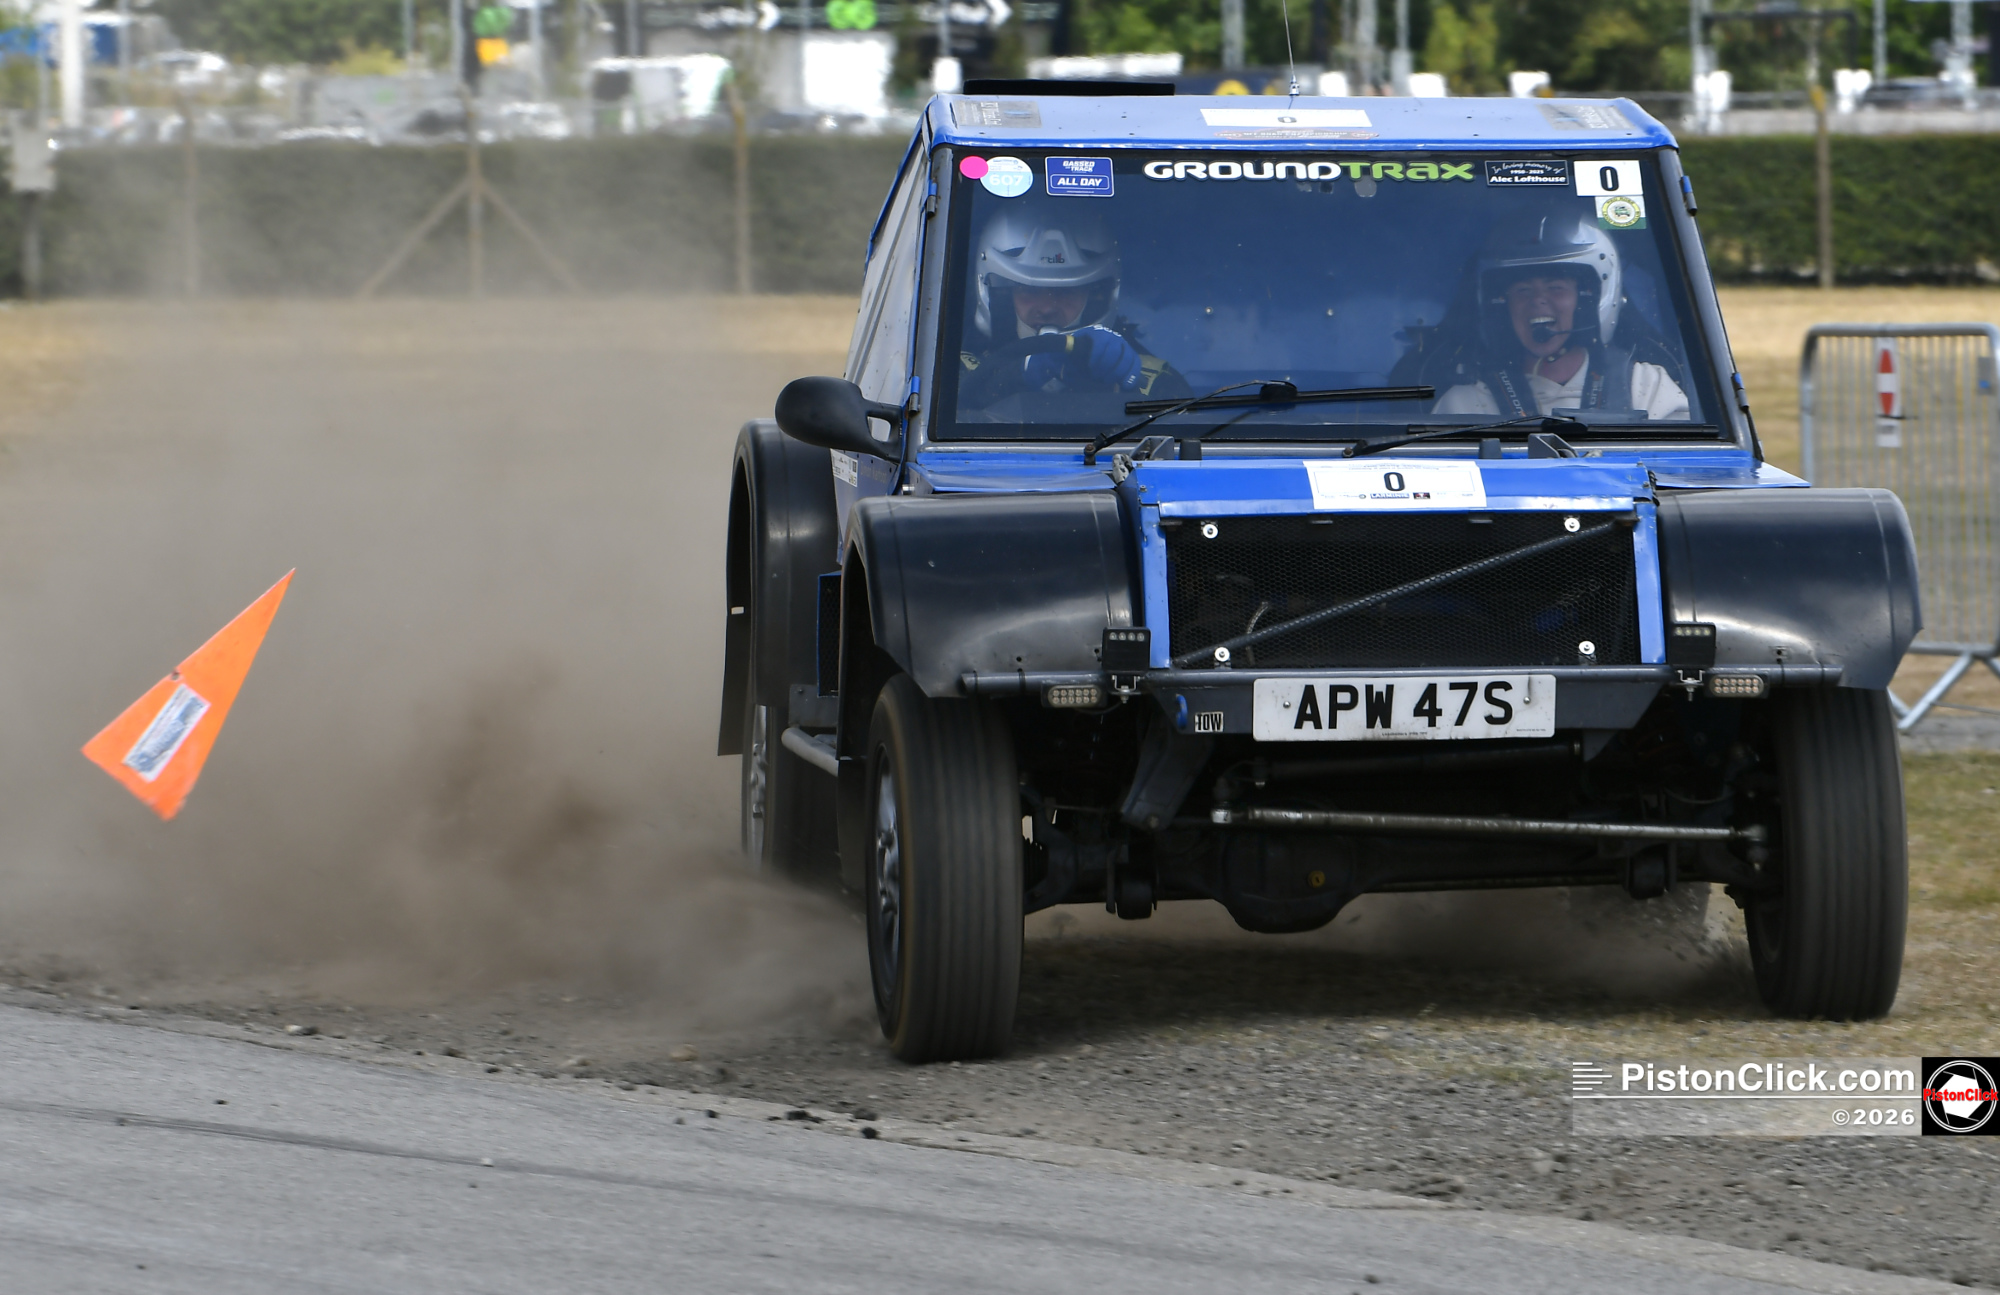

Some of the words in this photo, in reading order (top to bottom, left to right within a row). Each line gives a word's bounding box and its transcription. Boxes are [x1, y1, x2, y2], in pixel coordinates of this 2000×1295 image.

[989, 174, 1024, 186] 607
[1057, 177, 1078, 186] ALL
[1080, 178, 1102, 187] DAY
[1599, 166, 1619, 191] 0
[1384, 472, 1405, 491] 0
[1294, 684, 1394, 730] APW
[1413, 681, 1514, 728] 47S
